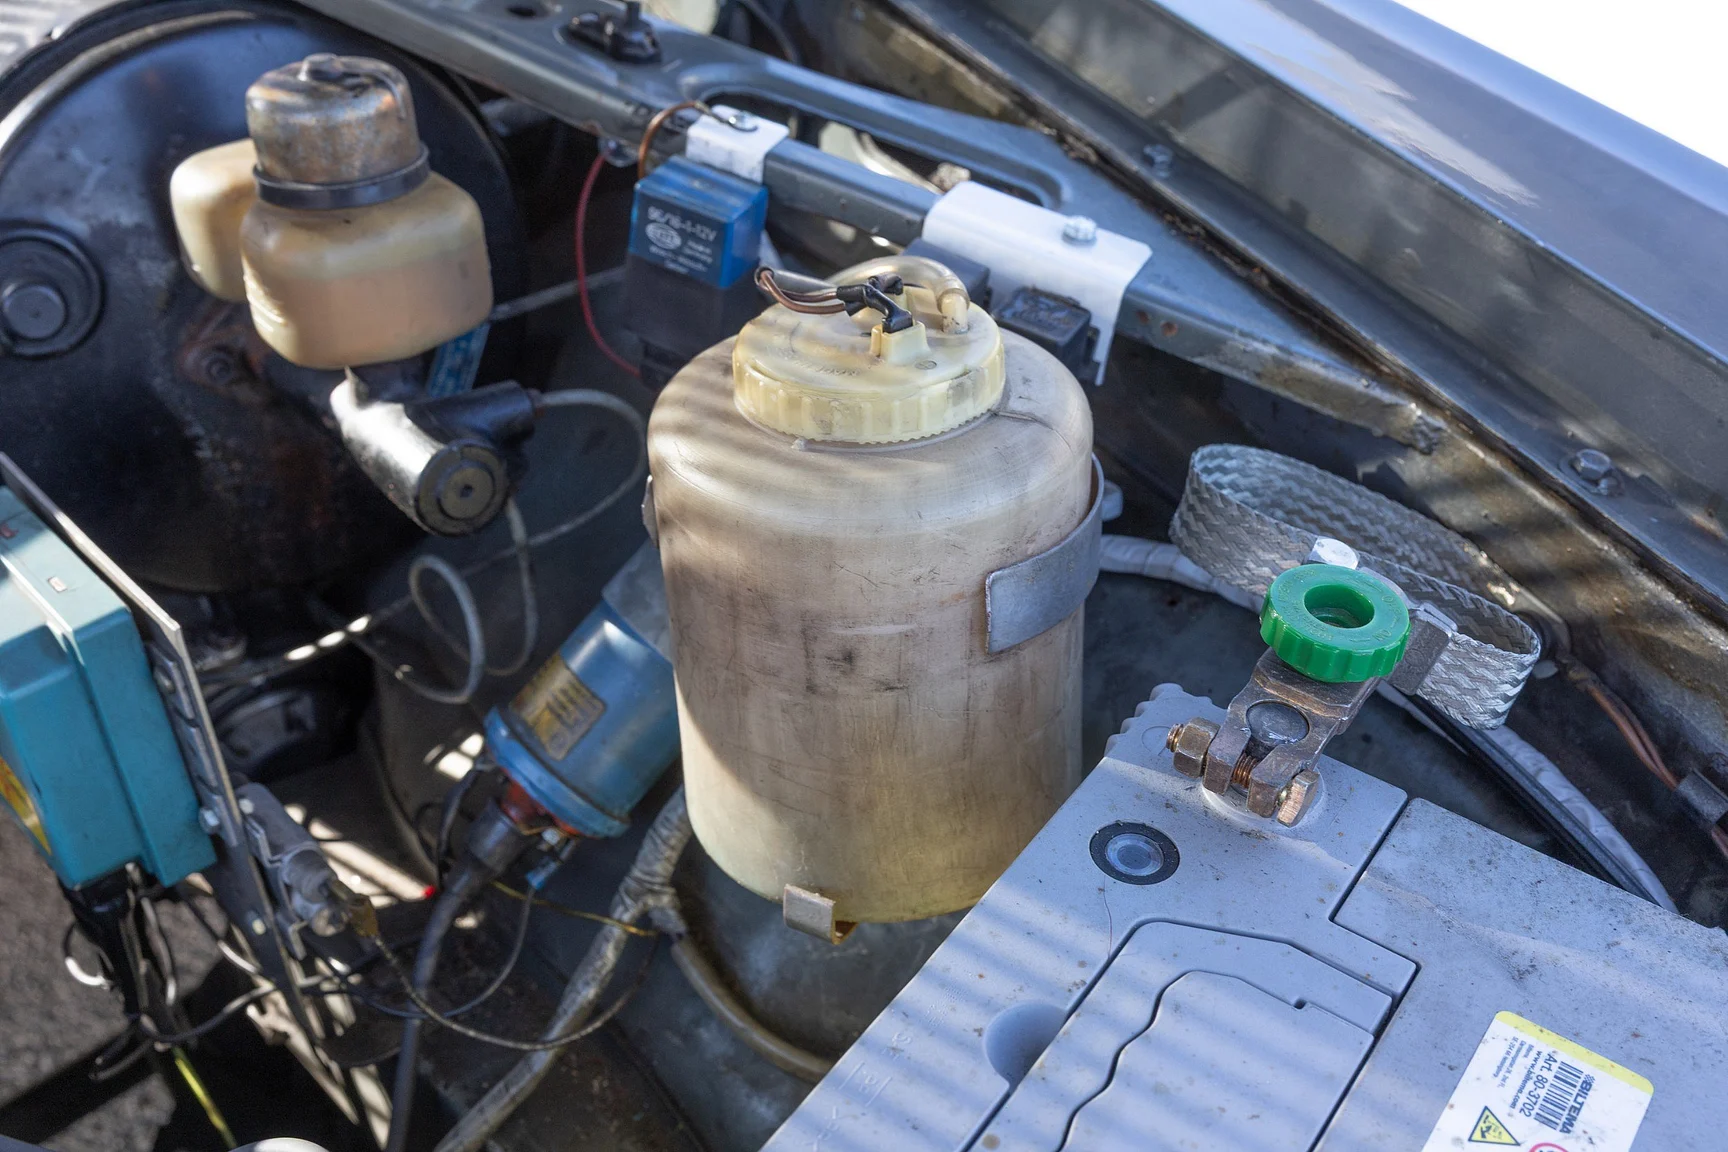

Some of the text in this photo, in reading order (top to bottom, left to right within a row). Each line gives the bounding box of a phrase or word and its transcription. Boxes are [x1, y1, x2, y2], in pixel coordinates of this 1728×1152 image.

[1510, 1050, 1543, 1110] www.biltema.com
[1519, 1054, 1558, 1118] Art. 80-3702
[1560, 1080, 1593, 1134] BILTEMA
